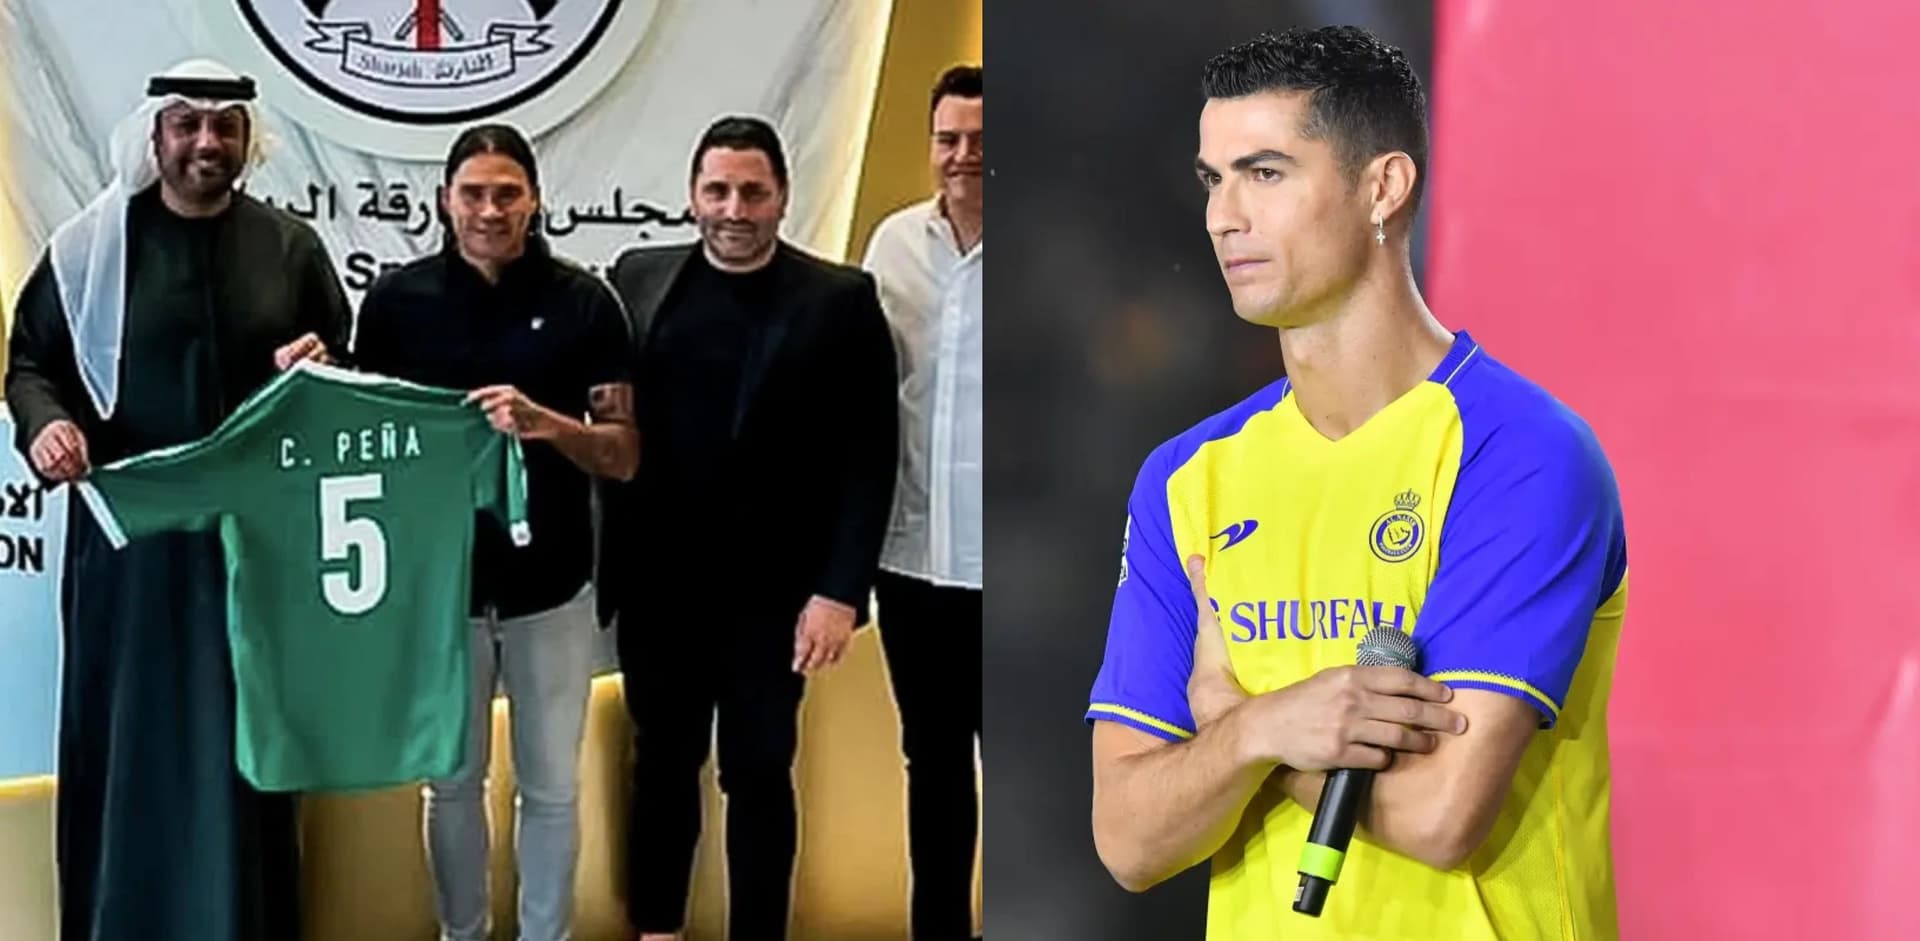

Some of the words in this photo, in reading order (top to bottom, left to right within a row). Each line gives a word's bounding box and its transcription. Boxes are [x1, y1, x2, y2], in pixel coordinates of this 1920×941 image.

[280, 438, 312, 468] C.
[337, 423, 420, 463] PEÑA
[319, 473, 386, 614] 5
[1230, 599, 1406, 643] SHURFAH
